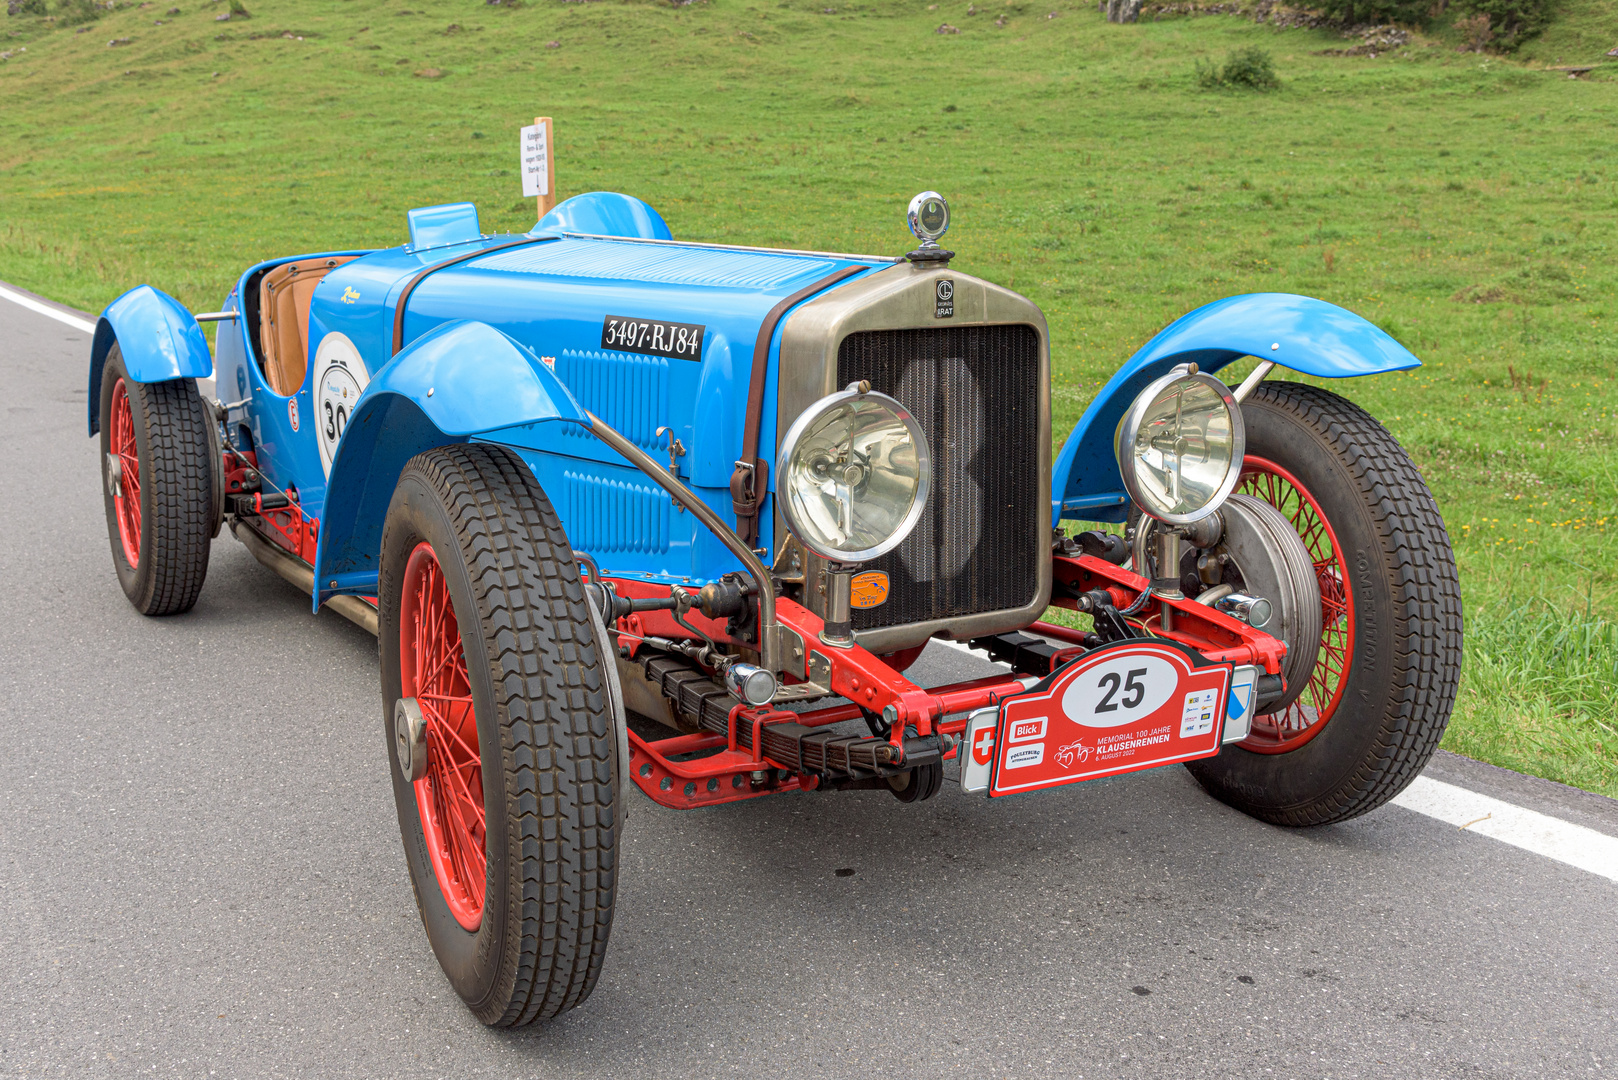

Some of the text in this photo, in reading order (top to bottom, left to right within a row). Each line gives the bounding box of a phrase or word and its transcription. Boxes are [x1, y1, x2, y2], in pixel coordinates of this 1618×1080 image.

[1094, 667, 1147, 714] 25
[1017, 724, 1037, 736] Blick
[1097, 732, 1134, 745] MEMORIAL
[1136, 729, 1148, 739] 100
[1149, 725, 1172, 736] JAHRE
[1096, 733, 1170, 755] KLAUSENRENNEN
[1101, 751, 1122, 761] AUGUST
[1122, 749, 1136, 757] 2022
